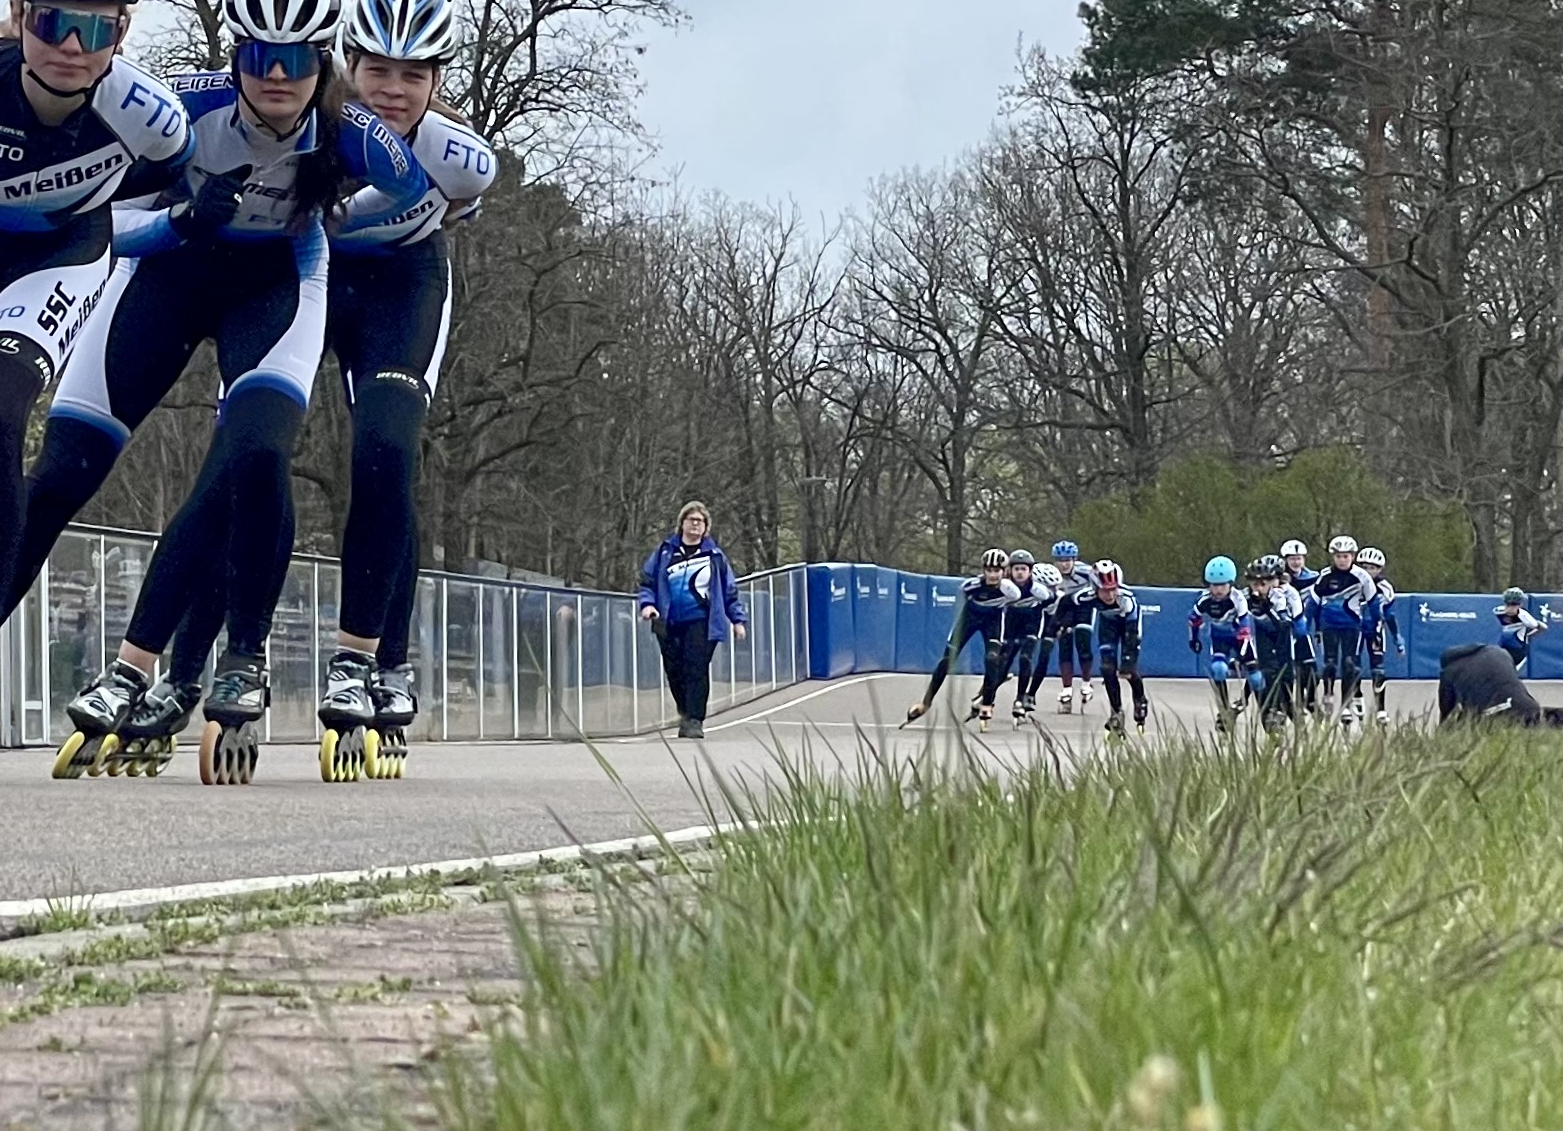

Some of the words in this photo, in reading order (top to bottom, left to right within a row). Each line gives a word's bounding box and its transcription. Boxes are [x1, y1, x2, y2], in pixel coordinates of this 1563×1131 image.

[120, 82, 183, 139] FTO
[4, 152, 123, 200] Meißen
[37, 280, 76, 336] SSC
